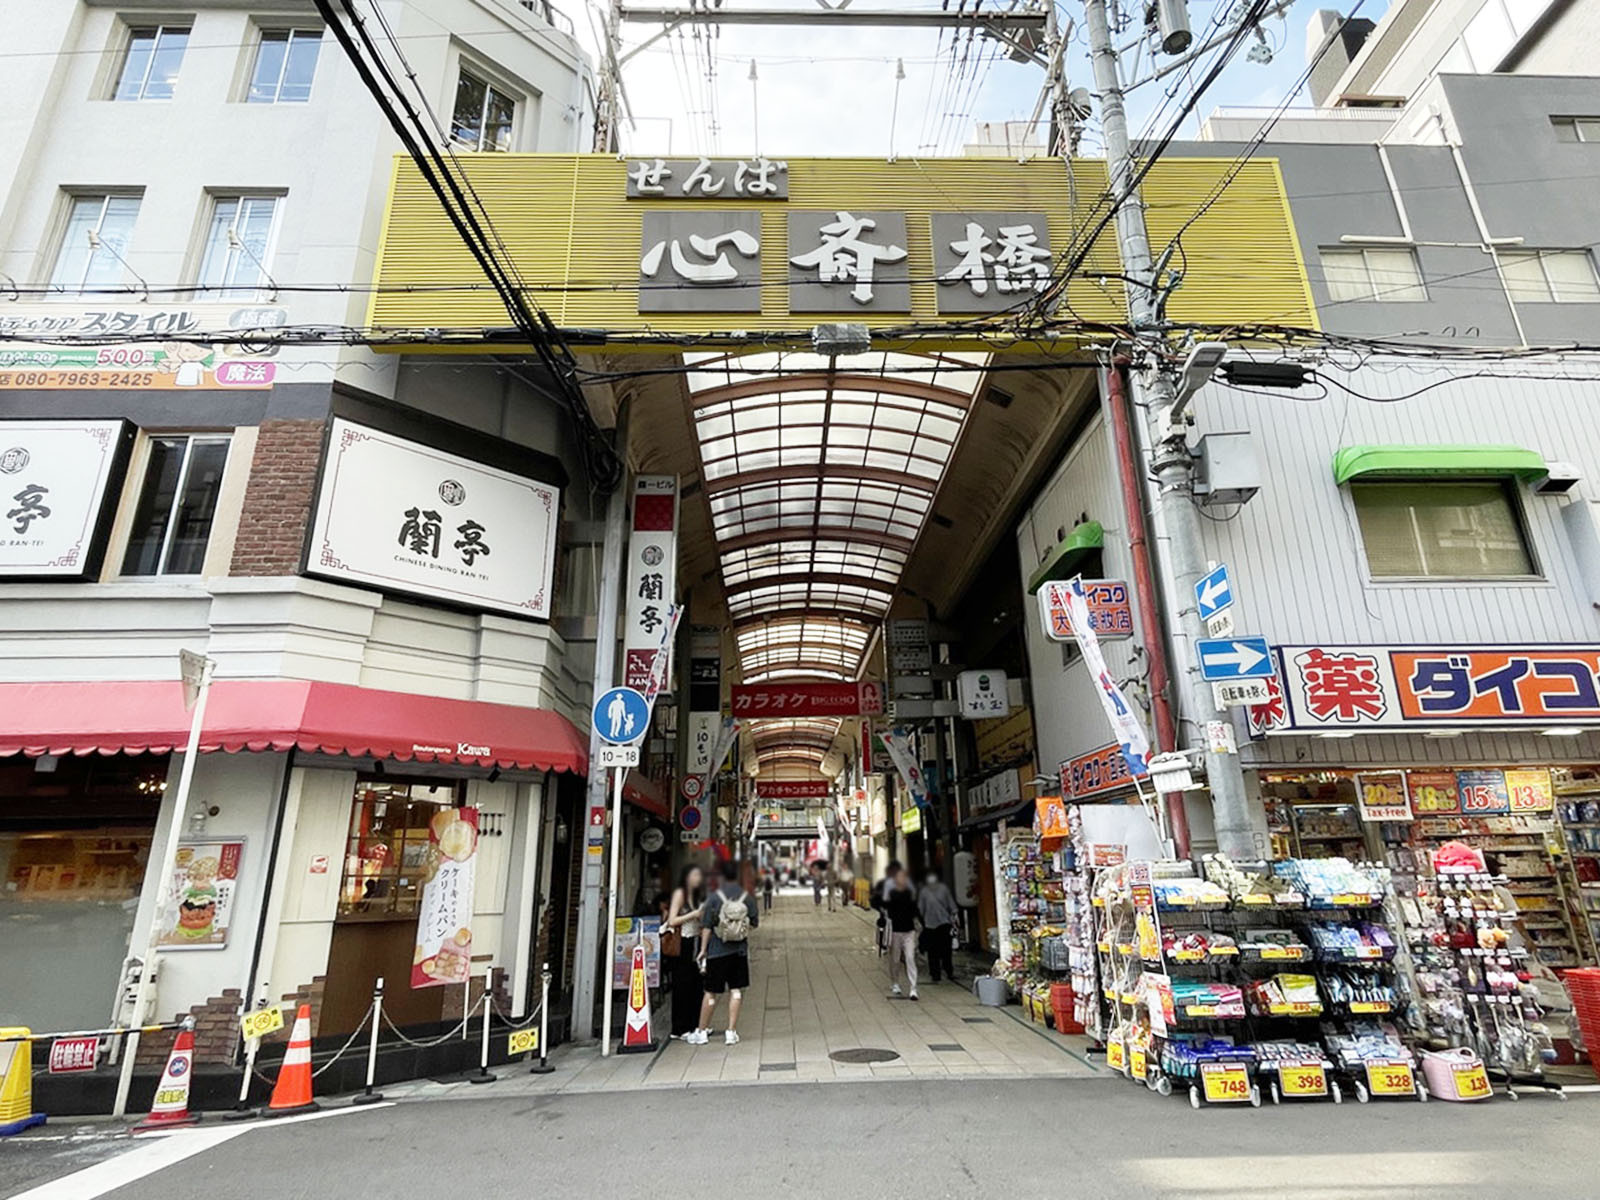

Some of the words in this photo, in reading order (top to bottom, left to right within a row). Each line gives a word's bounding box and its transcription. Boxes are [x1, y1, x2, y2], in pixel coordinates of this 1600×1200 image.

[629, 160, 786, 196] せんば
[642, 211, 1052, 305] 心斎橋
[80, 311, 197, 333] スタイル
[97, 349, 144, 364] 500
[15, 373, 154, 386] 080-7963-2425
[398, 507, 490, 566] 蘭亭
[638, 573, 663, 634] 蘭亭
[1222, 685, 1271, 701] 自転車を除く
[1296, 649, 1387, 721] 薬
[1412, 657, 1600, 713] ダイコ
[735, 693, 808, 709] カラオケ
[456, 743, 491, 756] Kawa
[1366, 808, 1407, 817] Tax-Free
[437, 869, 450, 937] クリームパン
[1221, 1080, 1247, 1093] 748
[1298, 1075, 1323, 1088] 398
[1386, 1075, 1411, 1088] 328
